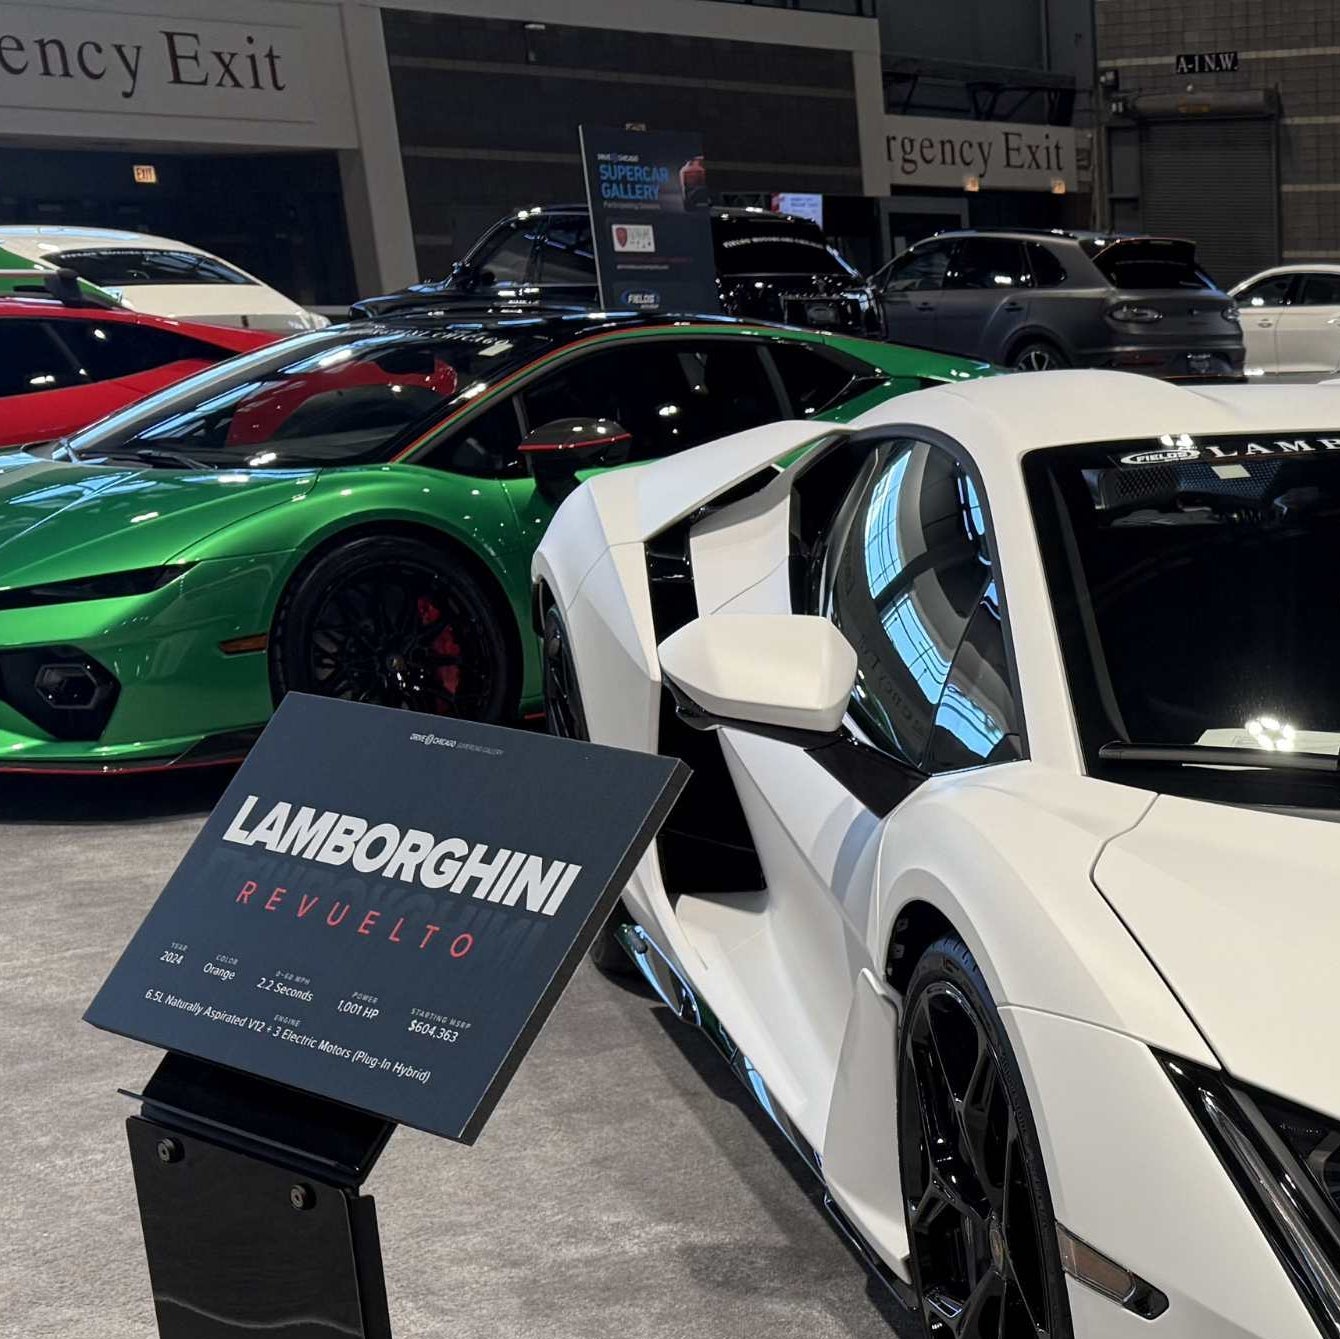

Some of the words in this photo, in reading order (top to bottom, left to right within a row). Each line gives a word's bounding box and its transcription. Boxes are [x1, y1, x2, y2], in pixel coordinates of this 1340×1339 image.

[0, 34, 142, 98] ency
[159, 30, 286, 91] Exit
[1002, 131, 1064, 171] Exit
[599, 164, 669, 183] SUPERCAR
[601, 183, 660, 200] GALLERY
[222, 795, 582, 916] LAMBORGHINI
[236, 881, 474, 958] REVUELTO
[160, 950, 184, 965] 2024
[216, 954, 238, 965] COLOR
[203, 962, 236, 981] Orange
[257, 977, 274, 991] 2.2
[274, 982, 314, 1002] Seconds
[352, 991, 379, 1004] POWER
[362, 1007, 379, 1019] HP
[410, 1007, 448, 1024] STARTING
[145, 989, 164, 1003] 6.5L
[164, 994, 203, 1016] Naturally
[203, 1006, 248, 1027] Aspirated
[248, 1018, 266, 1033] V12
[281, 1028, 318, 1049] Electric
[318, 1039, 352, 1059] Motors
[352, 1049, 392, 1071] (Plug-In
[392, 1061, 431, 1084] Hybrid)
